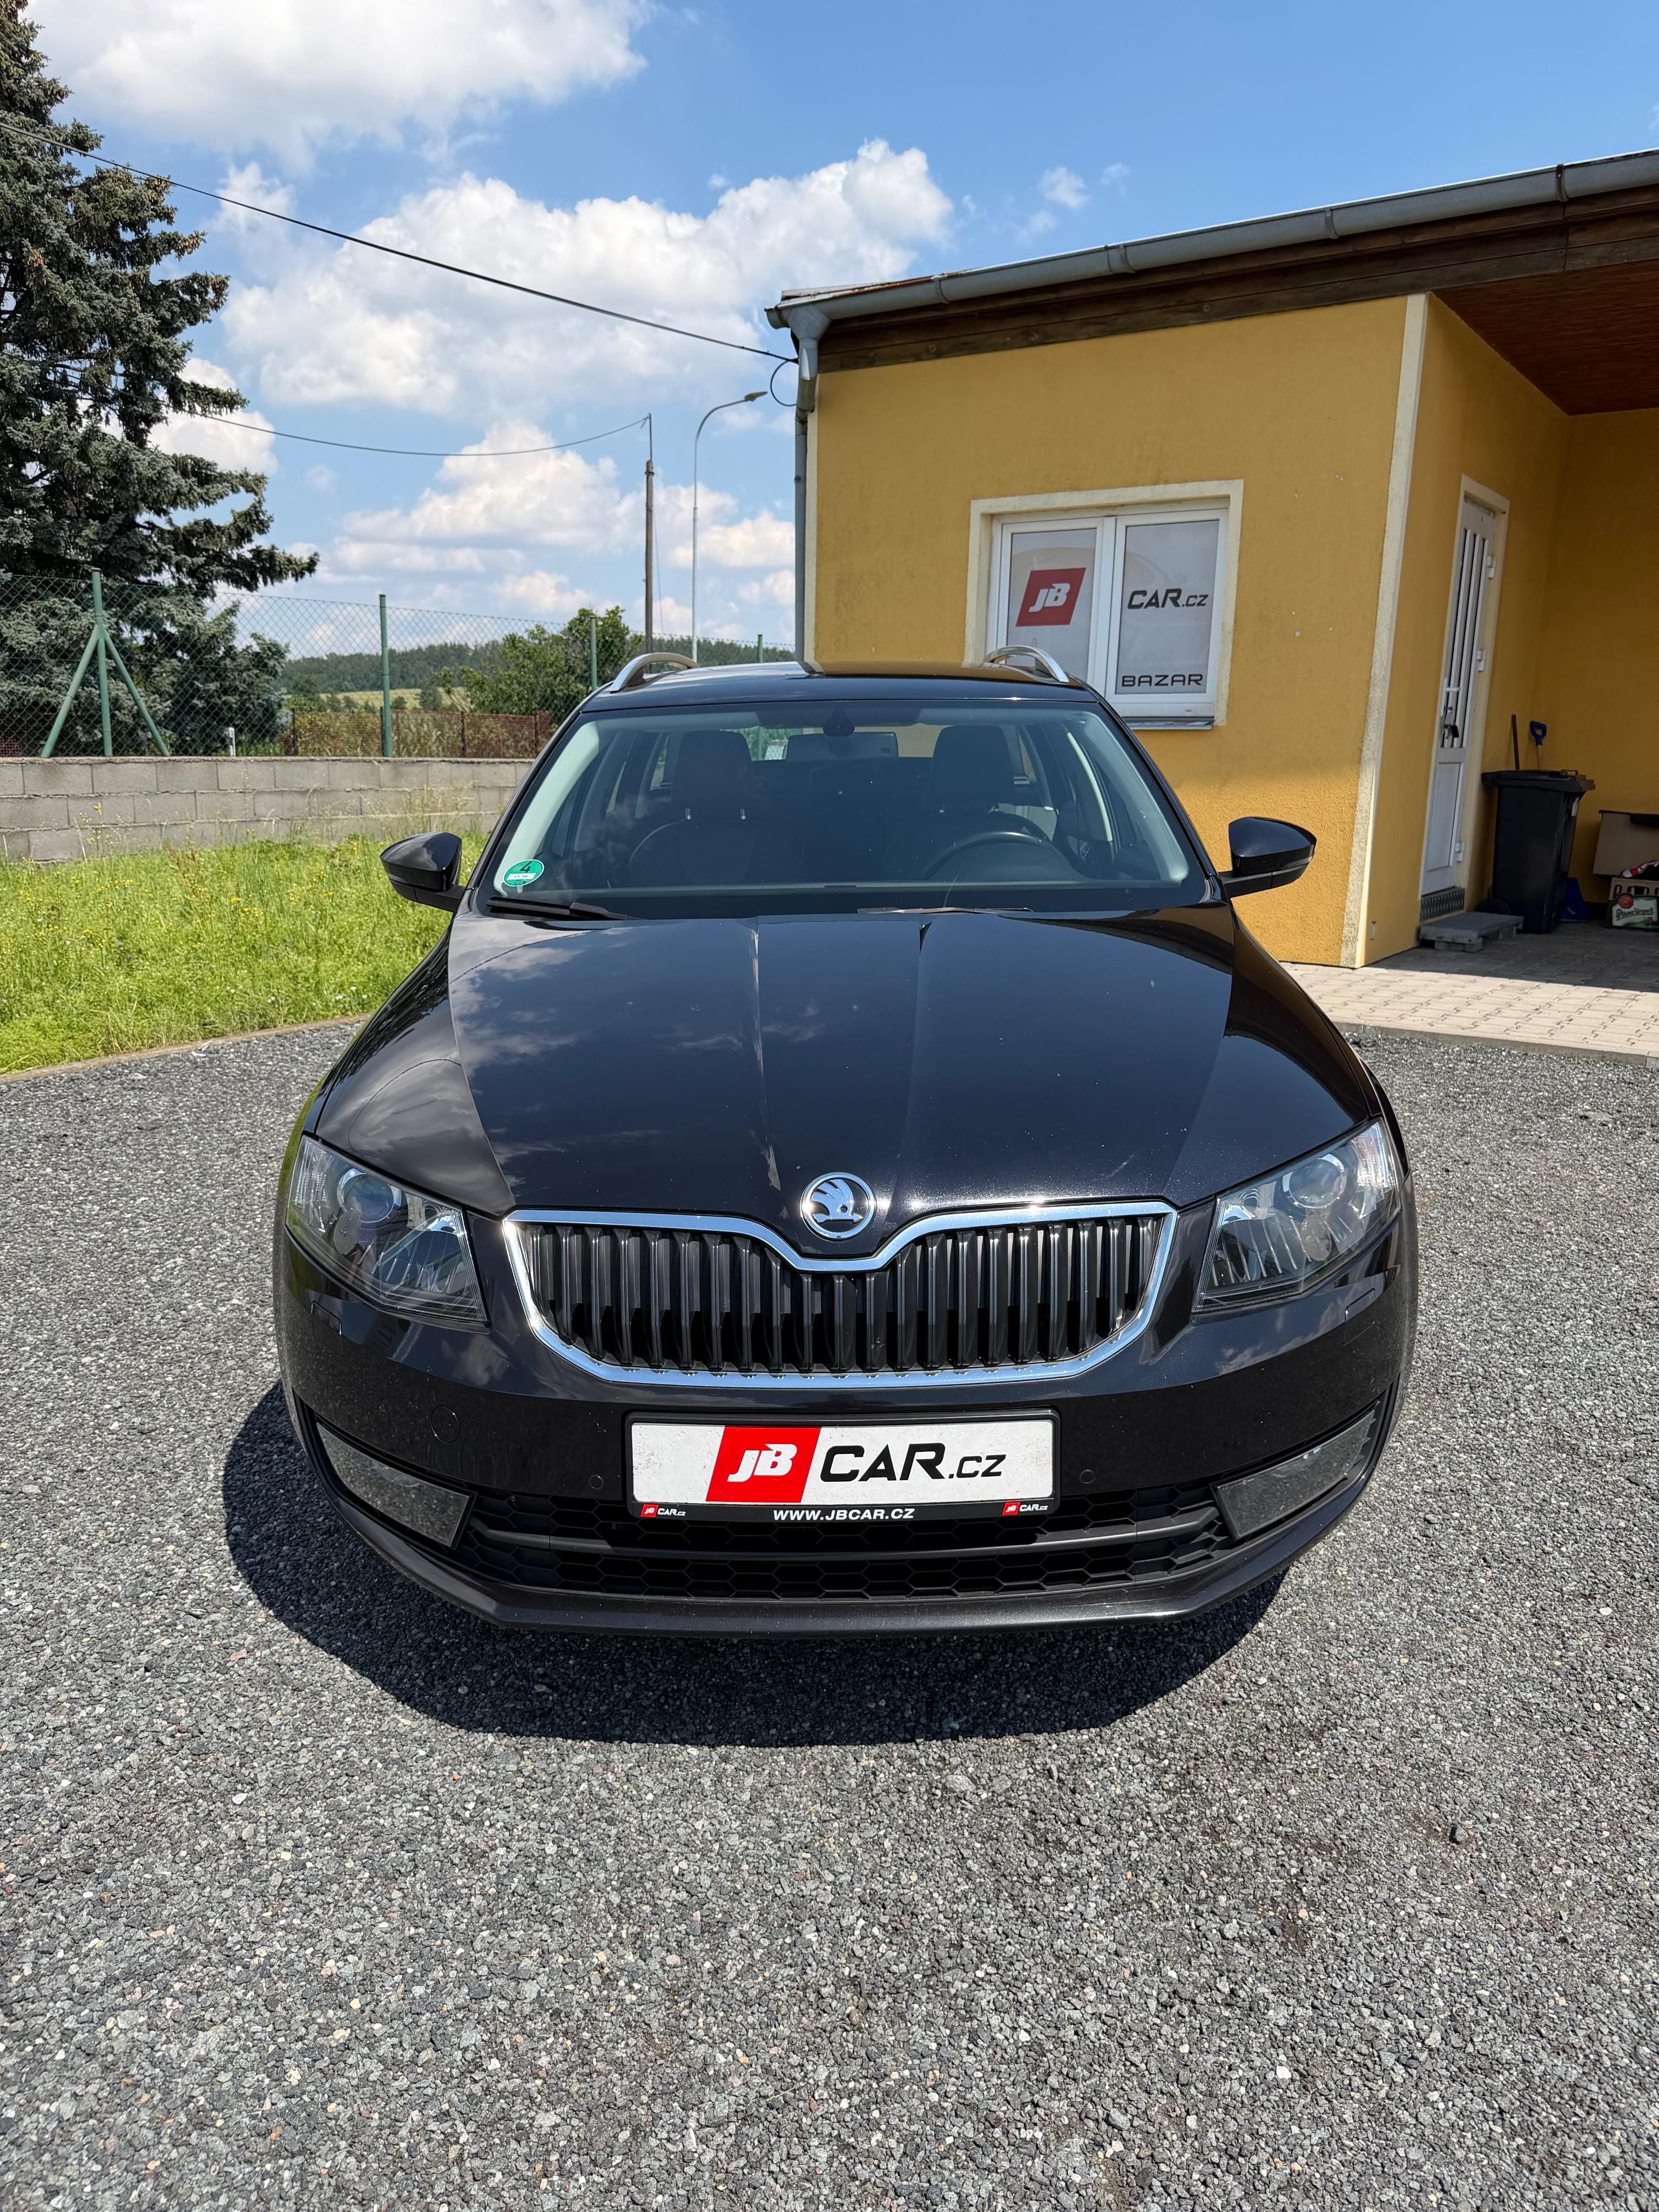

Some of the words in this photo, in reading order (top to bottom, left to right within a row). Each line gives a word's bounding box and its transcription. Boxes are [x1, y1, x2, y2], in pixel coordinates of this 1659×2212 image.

[1029, 583, 1070, 612] JB
[1122, 674, 1203, 687] BAZAR
[520, 861, 532, 873] 4
[727, 1444, 798, 1483] JB
[773, 1508, 915, 1521] WWW.JBCAR.CZ
